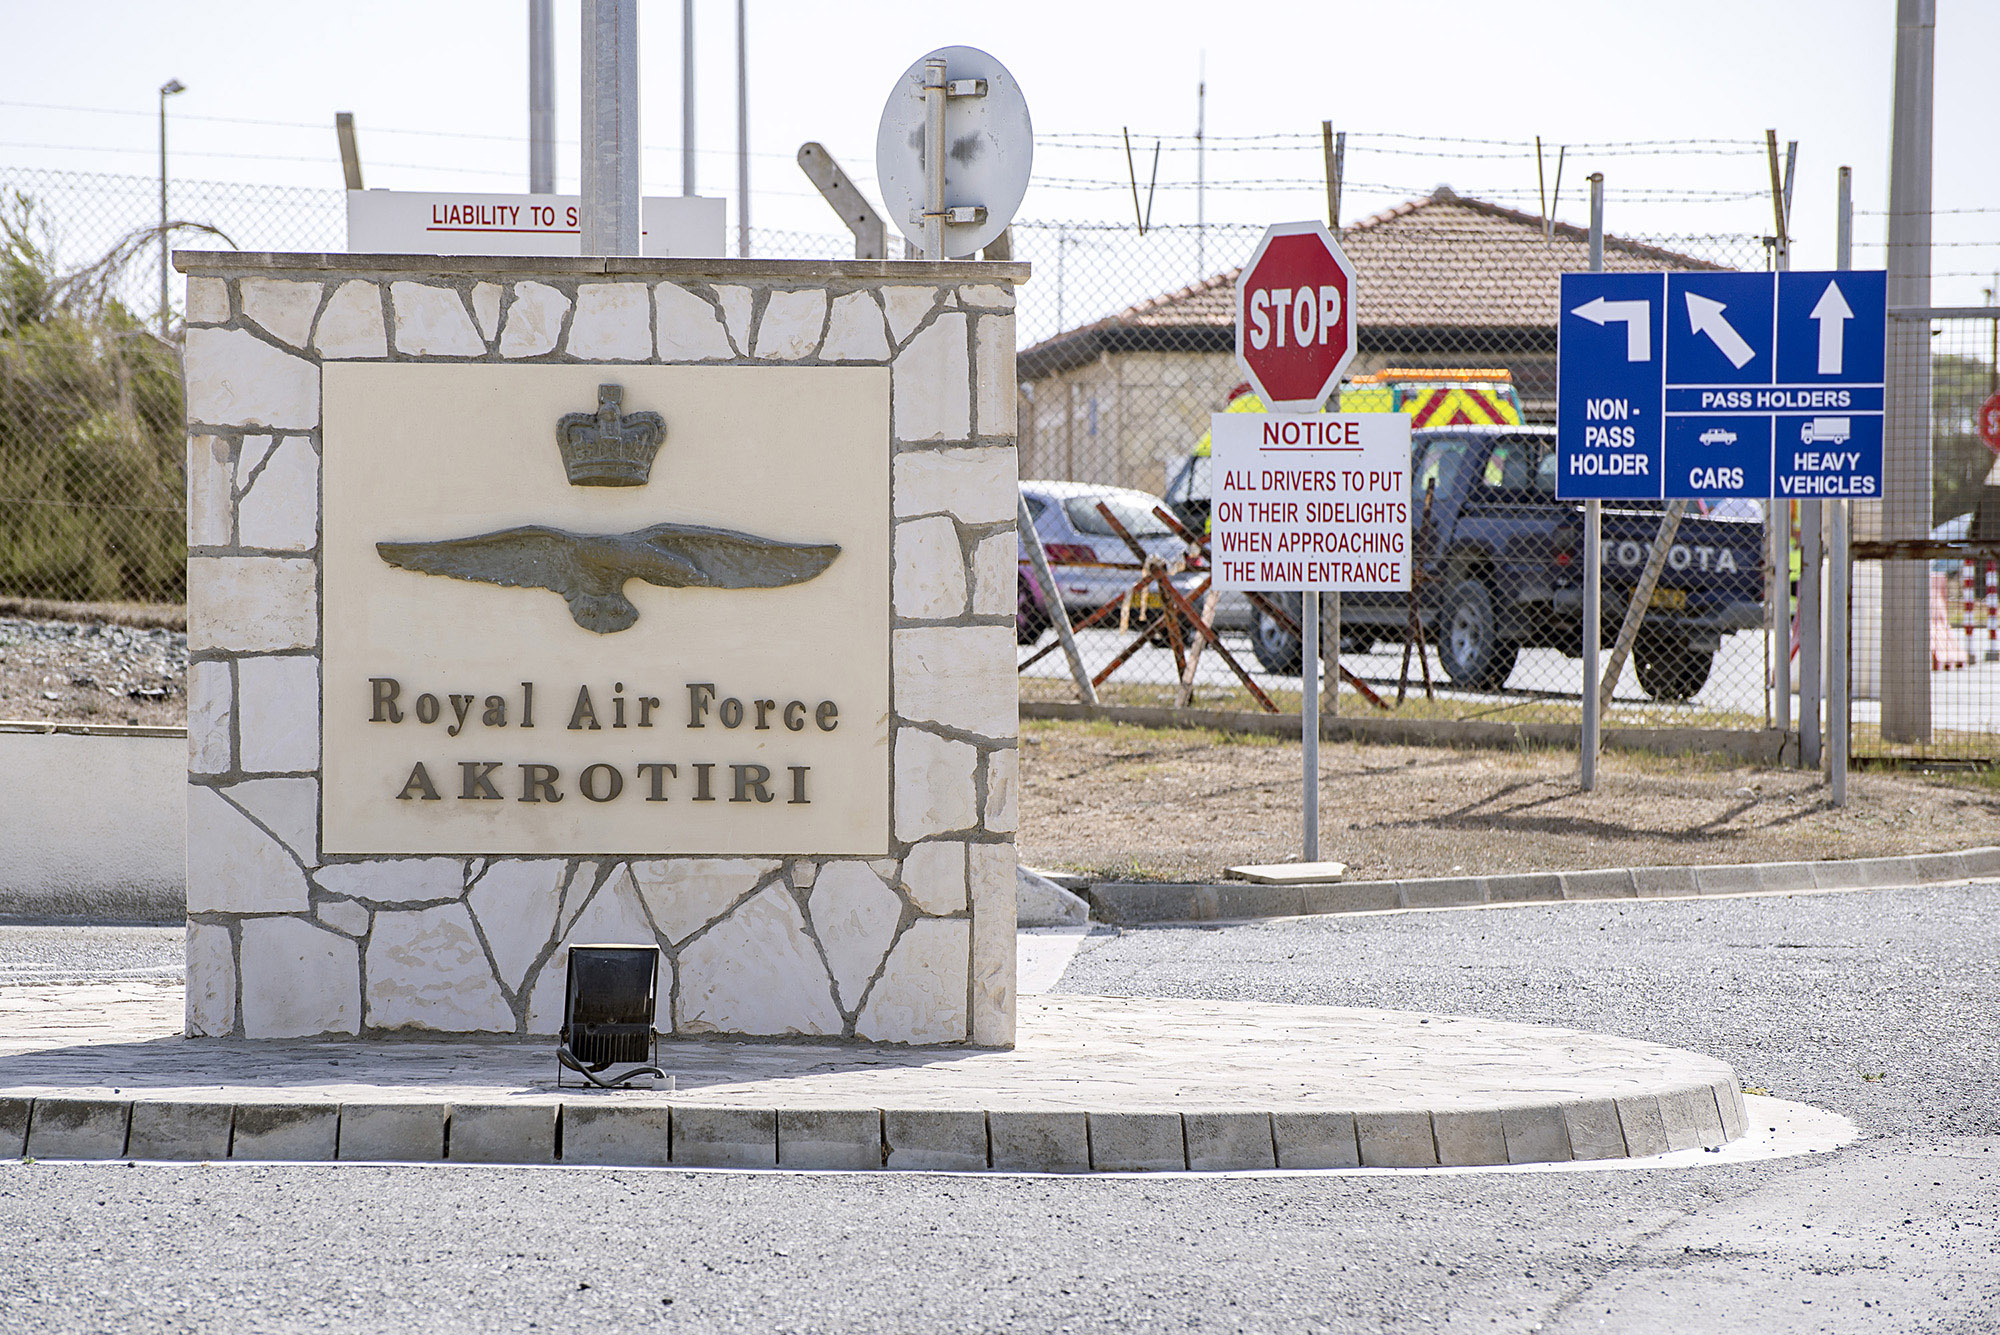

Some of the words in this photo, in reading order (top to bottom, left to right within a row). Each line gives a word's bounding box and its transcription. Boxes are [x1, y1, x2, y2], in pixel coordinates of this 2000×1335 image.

[432, 204, 520, 226] LIABILITY
[530, 206, 555, 227] TO
[566, 206, 581, 228] S
[1250, 286, 1341, 349] STOP
[1701, 391, 1752, 408] PASS
[1756, 390, 1851, 408] HOLDERS
[1262, 422, 1360, 445] NOTICE
[1585, 426, 1635, 447] PASS
[1570, 454, 1649, 475] HOLDER
[1793, 452, 1861, 471] HEAVY
[1223, 470, 1256, 491] ALL
[1262, 470, 1336, 492] DRIVERS
[1342, 471, 1364, 492] TO
[1370, 471, 1402, 492] PUT
[1689, 467, 1744, 489] CARS
[1779, 475, 1876, 494] VEHICLES
[1218, 502, 1242, 523] ON
[1248, 502, 1298, 523] THEIR
[1306, 502, 1407, 523] SIDELIGHTS
[1221, 532, 1272, 553] WHEN
[1277, 532, 1404, 553] APPROACHING
[1600, 539, 1738, 574] TOOTA
[1223, 561, 1256, 582] THE
[1261, 562, 1303, 583] MAIN
[1307, 562, 1401, 583] ENTRANCE
[368, 677, 535, 737] Royal
[567, 681, 660, 731] Air
[686, 683, 840, 732] Force
[395, 761, 811, 804] AKROTIRI
